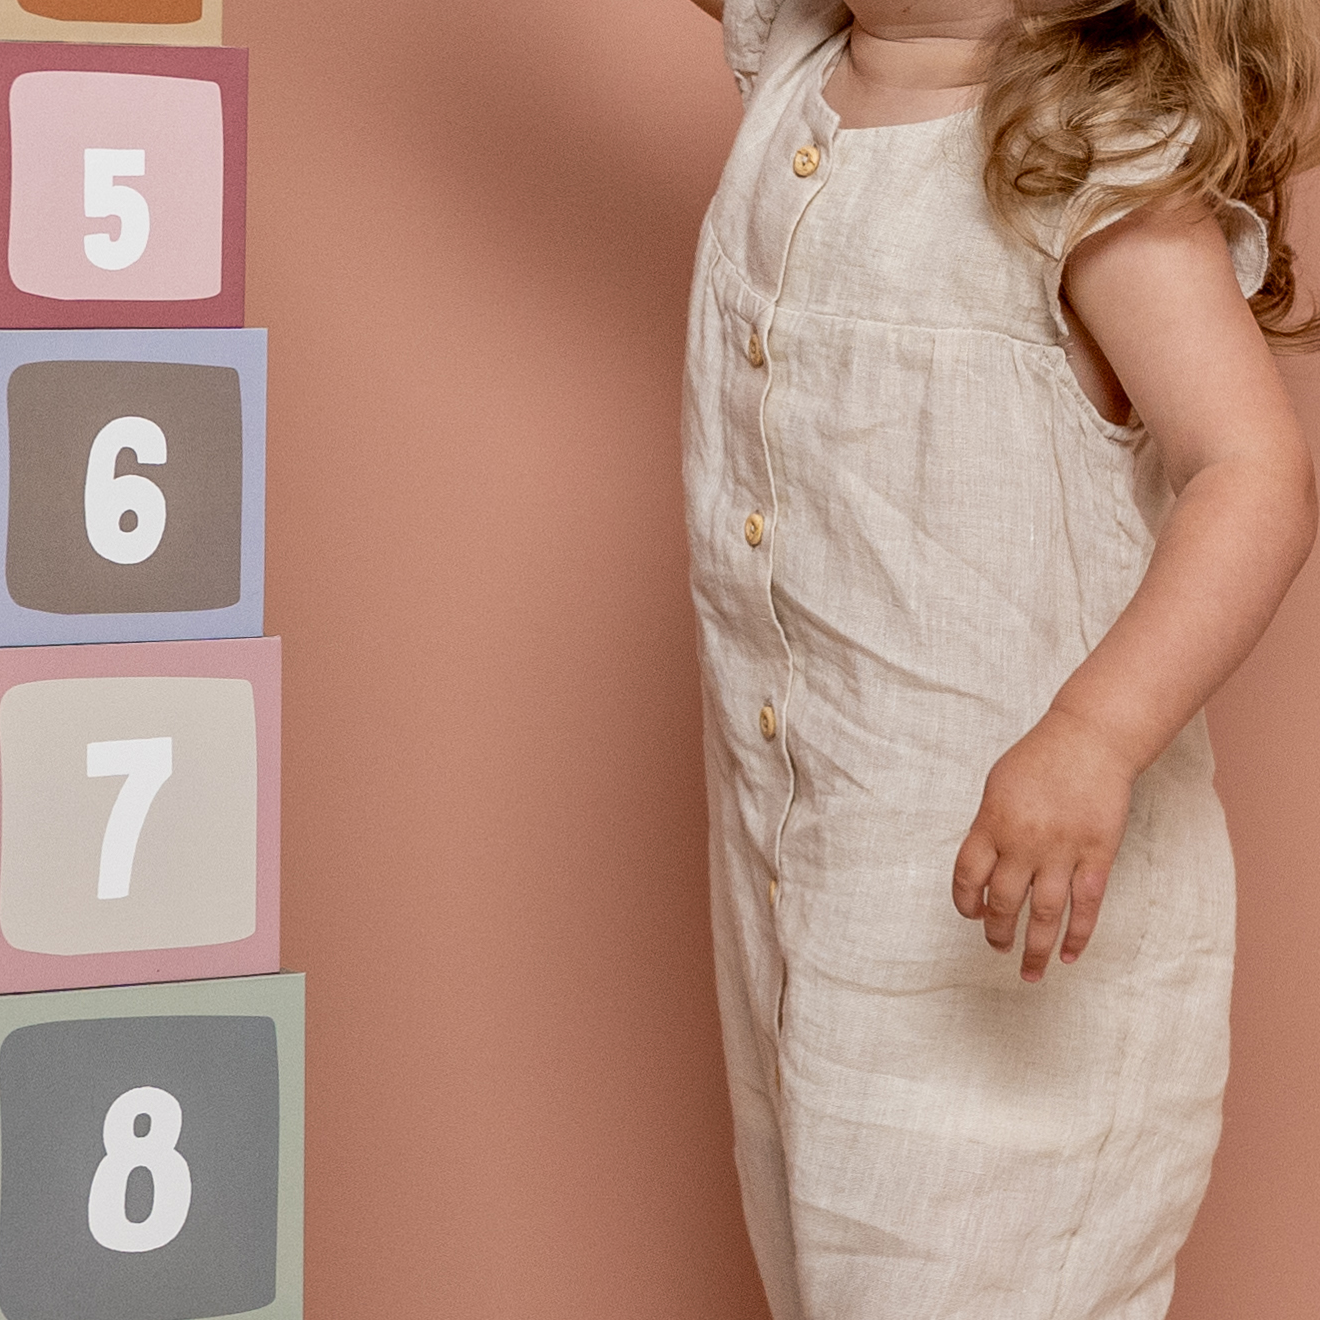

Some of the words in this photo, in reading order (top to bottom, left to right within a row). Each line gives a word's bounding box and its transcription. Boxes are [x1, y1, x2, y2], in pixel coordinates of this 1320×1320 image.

[84, 148, 150, 270] 5
[86, 418, 165, 562] 6
[87, 737, 172, 899] 7
[89, 1086, 192, 1253] 8
